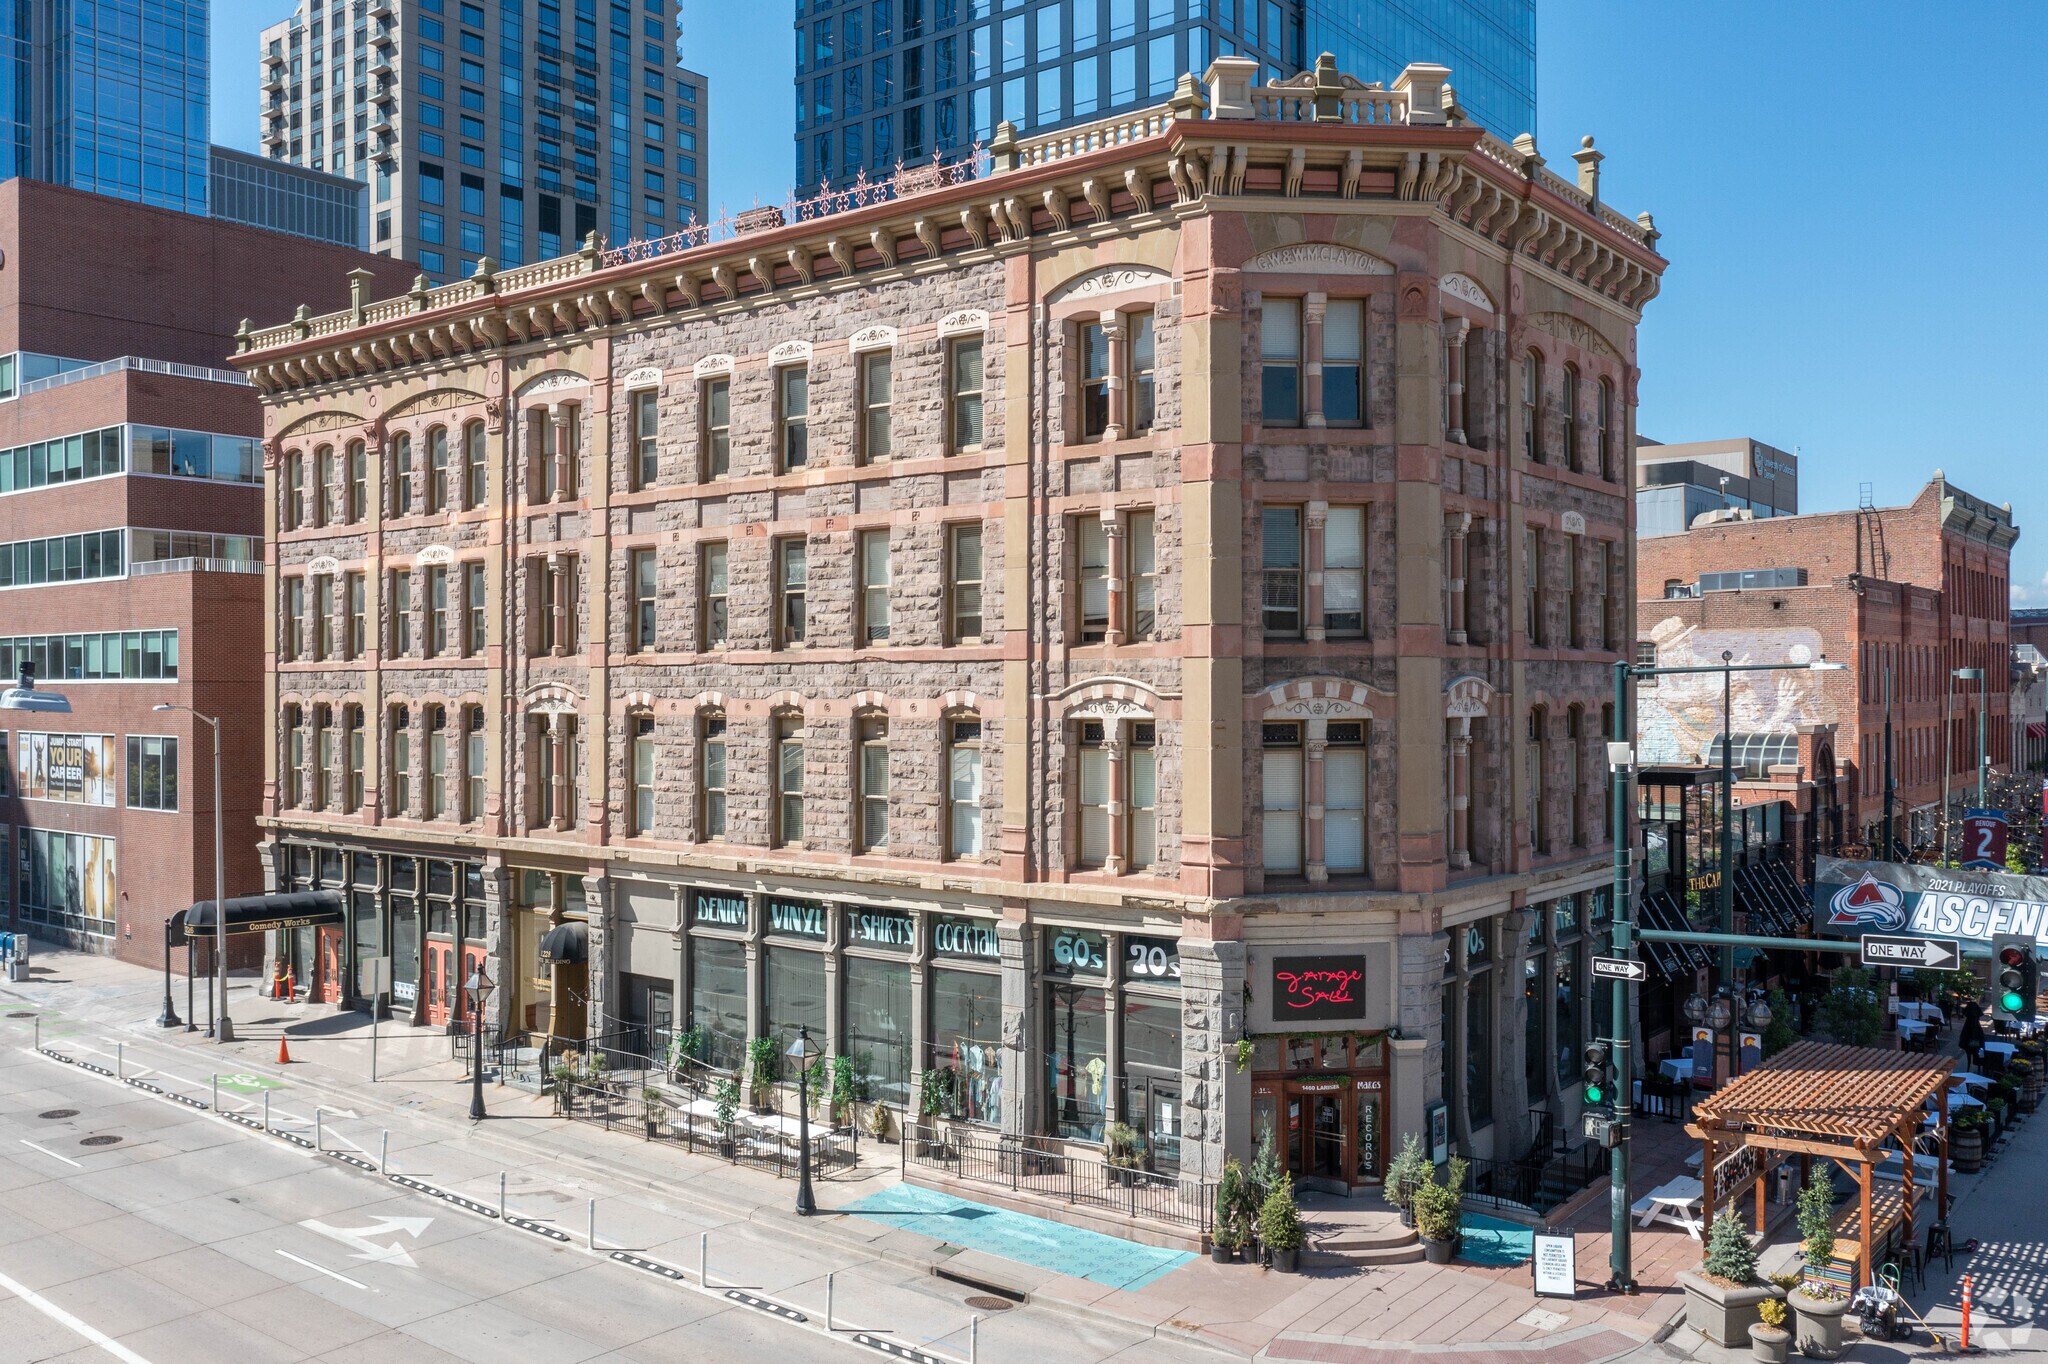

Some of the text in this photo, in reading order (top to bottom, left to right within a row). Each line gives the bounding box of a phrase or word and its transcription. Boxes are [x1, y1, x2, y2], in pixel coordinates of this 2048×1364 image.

[49, 747, 82, 766] YOUR
[50, 766, 82, 780] CAREER
[1976, 828, 1993, 857] 2
[1928, 878, 2006, 897] 2021 PLAYOFFS
[697, 895, 746, 925] DENIM
[771, 903, 826, 935] VINYL
[249, 918, 311, 931] Comedy Works
[848, 912, 914, 946] T-SHIRTS
[1054, 936, 1104, 969] 60s
[1870, 944, 1926, 958] ONE WAY
[1597, 963, 1629, 974] ONE WAY
